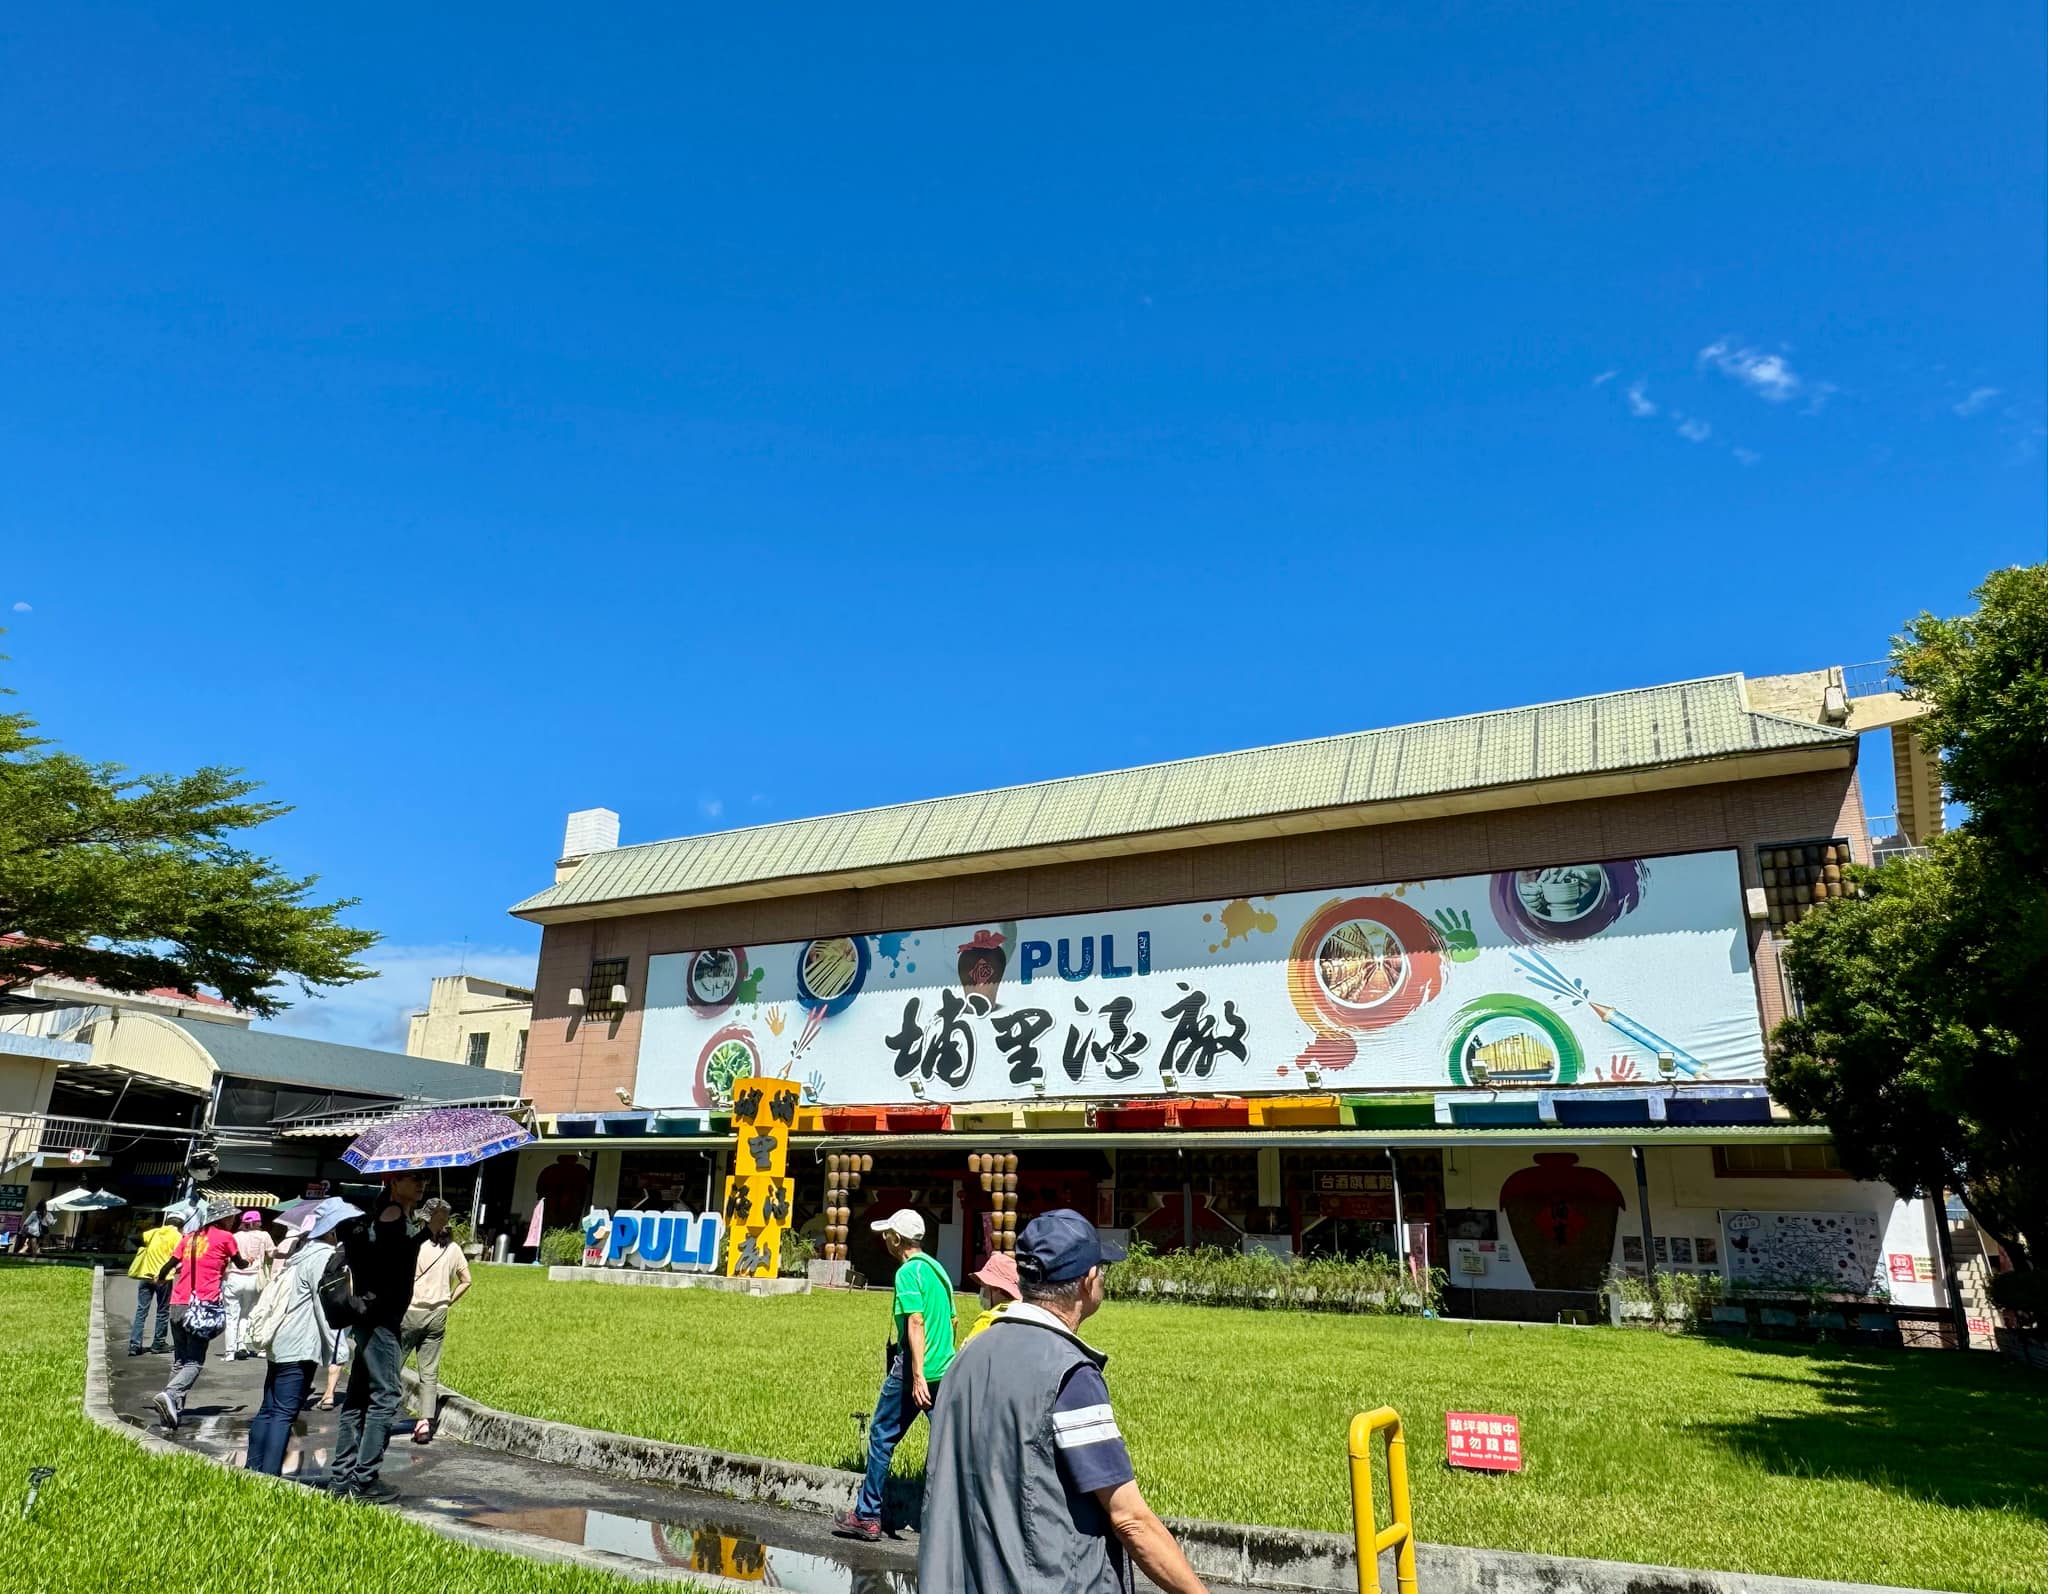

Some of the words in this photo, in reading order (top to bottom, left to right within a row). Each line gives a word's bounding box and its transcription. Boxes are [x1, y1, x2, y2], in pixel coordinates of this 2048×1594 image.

[1020, 931, 1151, 985] PULI
[885, 982, 1249, 1089] 埔里酒廠
[608, 1216, 717, 1266] PULI
